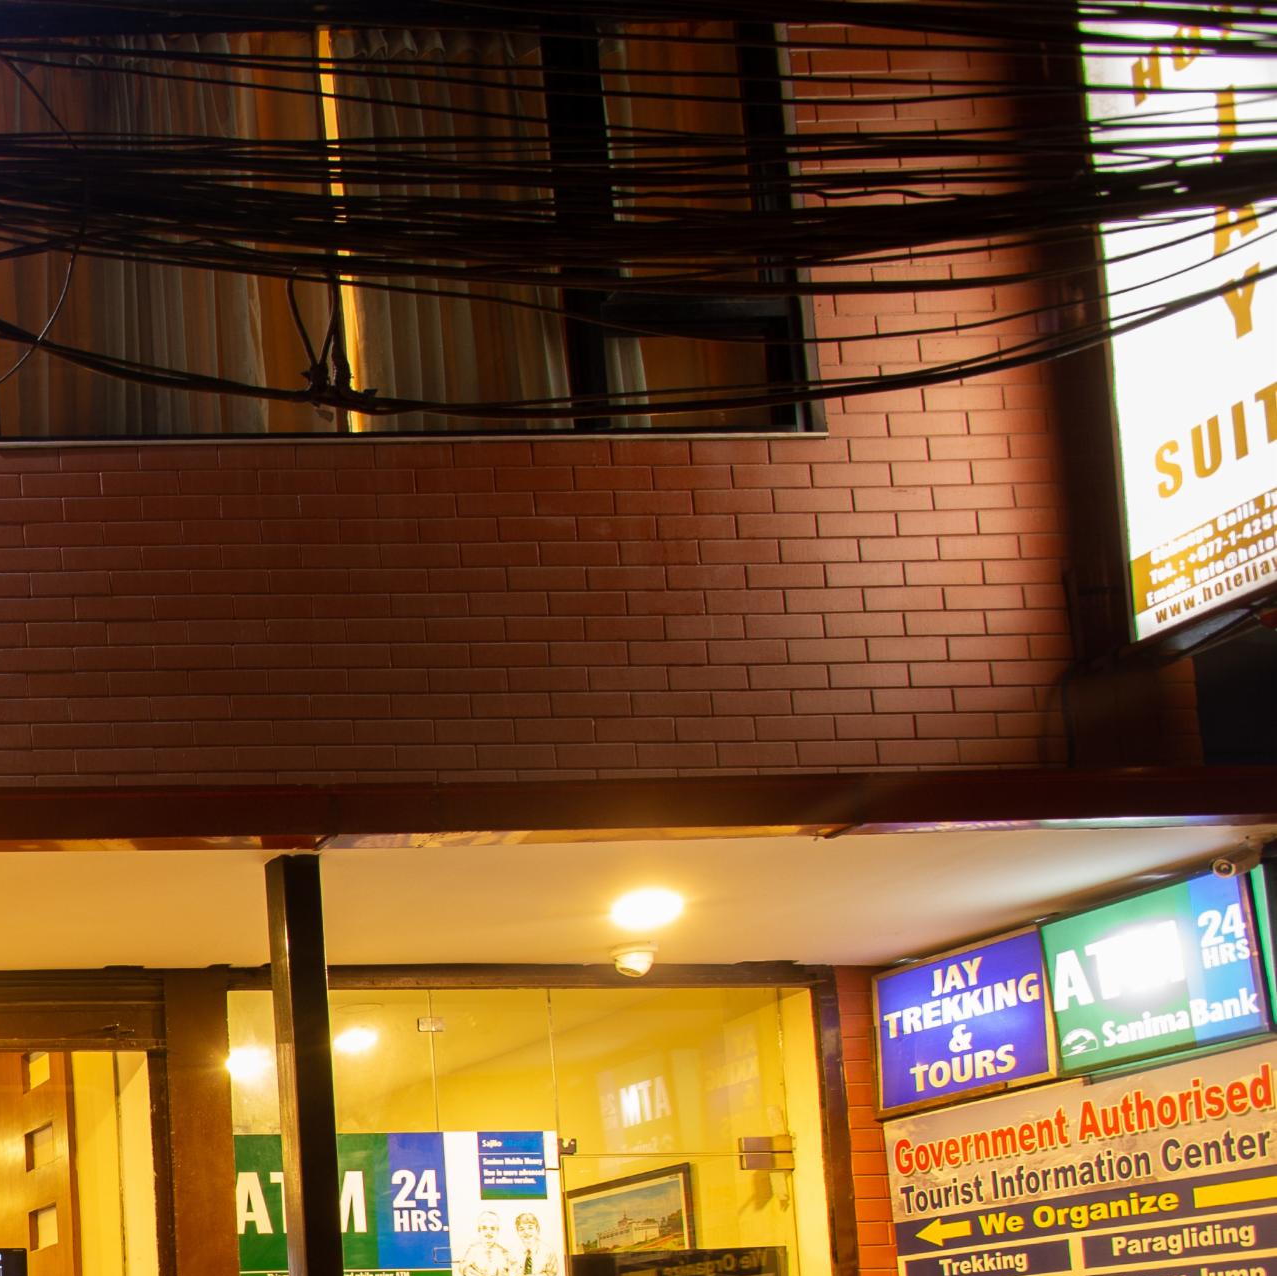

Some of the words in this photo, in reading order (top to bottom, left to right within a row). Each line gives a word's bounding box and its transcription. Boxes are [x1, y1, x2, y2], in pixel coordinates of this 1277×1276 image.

[1197, 903, 1246, 948] 24
[931, 955, 983, 997] JAY
[883, 972, 1041, 1039] TREKKING
[948, 1024, 972, 1053] &
[909, 1044, 1017, 1093] TOURS
[893, 1105, 1069, 1175] Government
[1078, 1063, 1275, 1143] Authorised
[391, 1169, 441, 1208] 24
[901, 1177, 984, 1215] Tourist
[992, 1150, 1151, 1200] Information
[1160, 1128, 1270, 1171] Center
[393, 1210, 450, 1233] HRS.
[979, 1209, 1024, 1236] We
[1033, 1189, 1180, 1230] Organize
[1111, 1222, 1256, 1257] Paragliding
